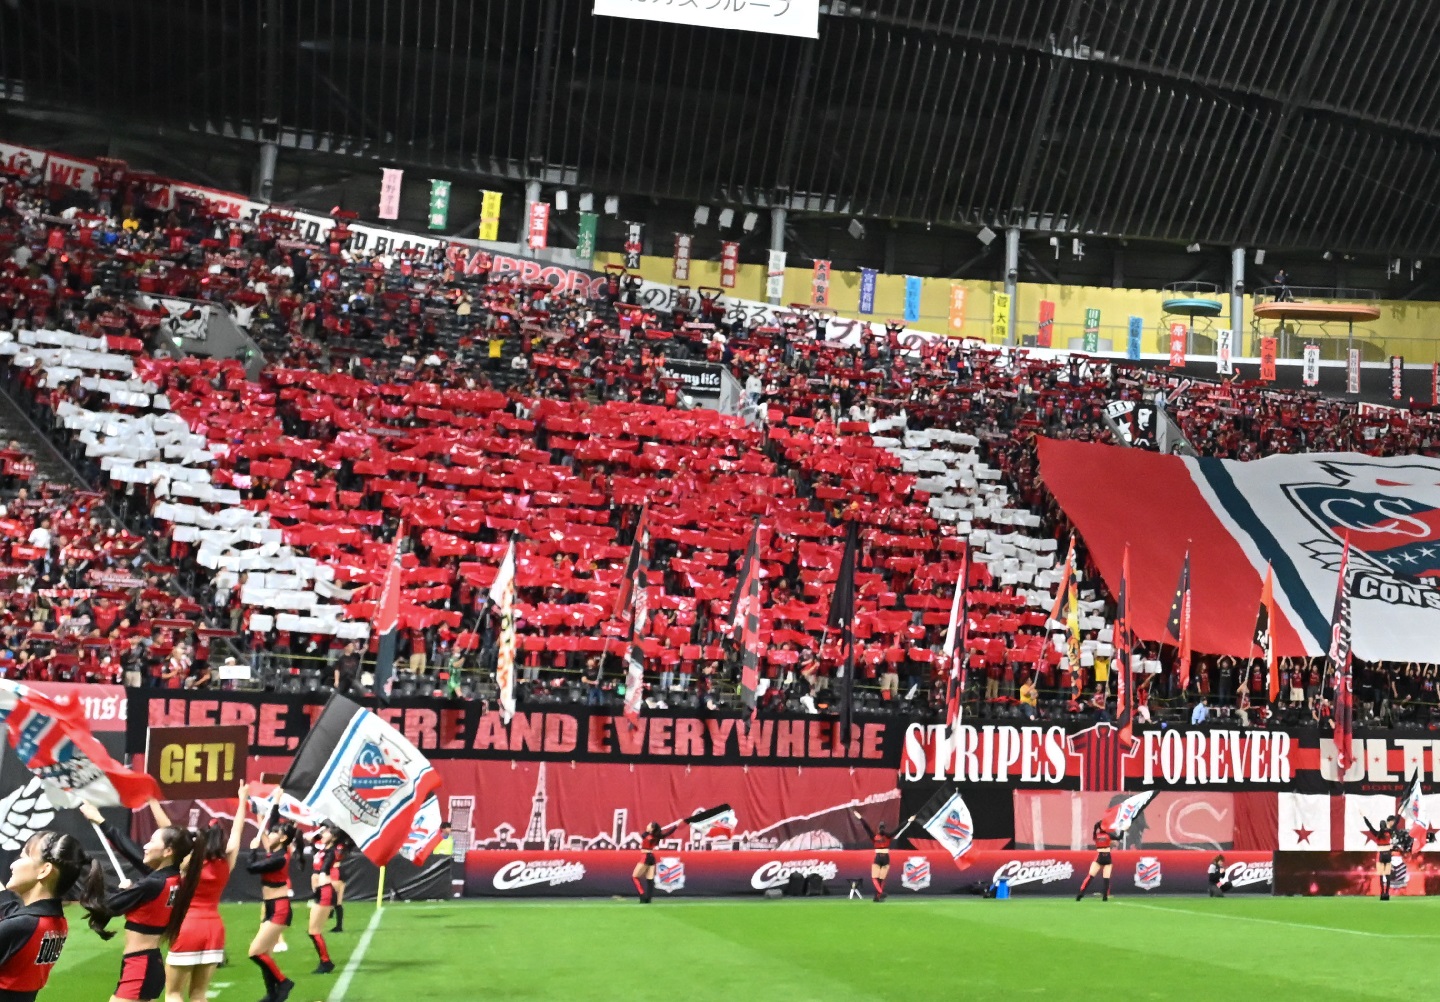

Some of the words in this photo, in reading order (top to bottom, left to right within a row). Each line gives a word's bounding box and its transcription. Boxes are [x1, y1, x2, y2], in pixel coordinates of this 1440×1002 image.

[587, 714, 886, 761] EVERYWHERE
[904, 721, 1067, 785] STRIPES
[1142, 727, 1292, 785] FOREVER
[159, 742, 237, 785] GET!
